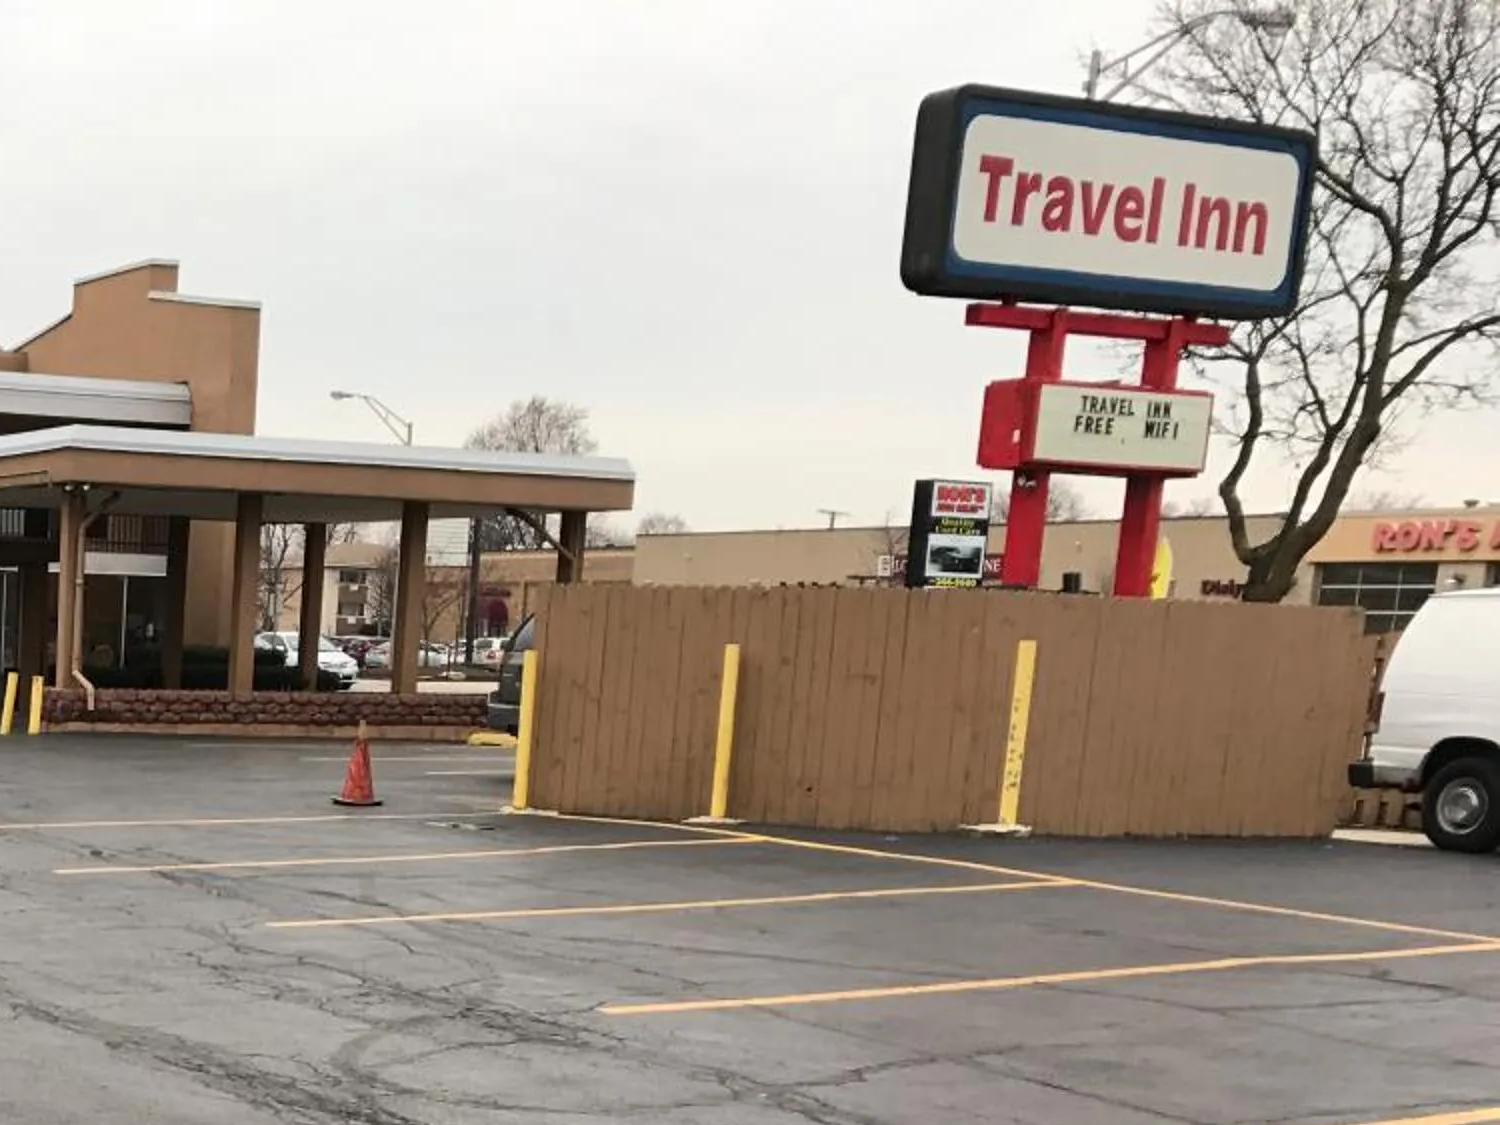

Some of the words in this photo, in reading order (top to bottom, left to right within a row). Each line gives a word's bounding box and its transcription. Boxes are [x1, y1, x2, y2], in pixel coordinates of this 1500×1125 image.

[979, 153, 1167, 244] Travel
[1177, 182, 1269, 256] Inn
[1081, 395, 1135, 417] TRAVEL
[1147, 401, 1173, 419] INN
[1073, 415, 1115, 435] FREE
[1143, 420, 1180, 440] WIFI
[1372, 520, 1480, 553] RON'S
